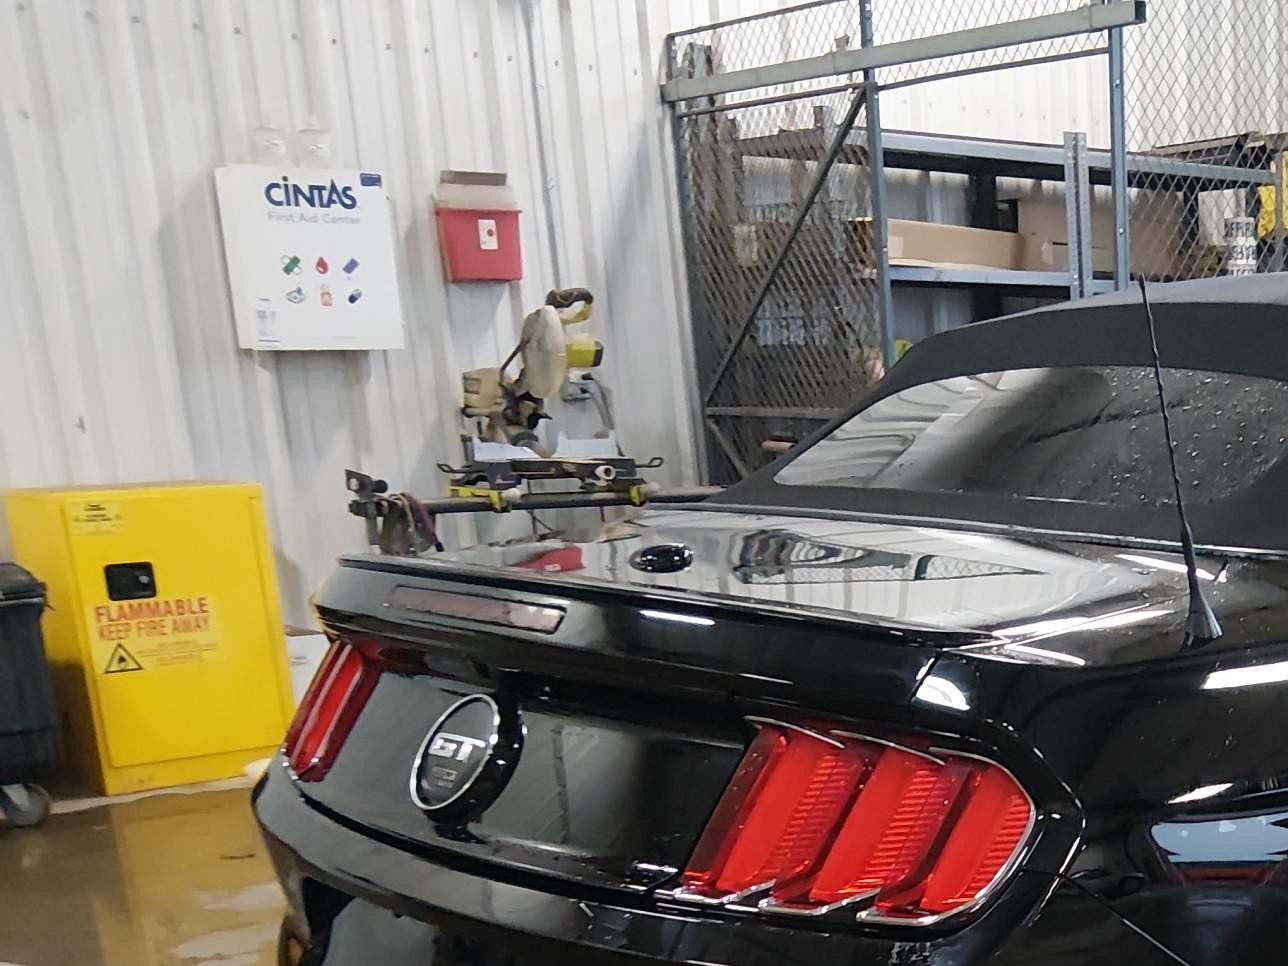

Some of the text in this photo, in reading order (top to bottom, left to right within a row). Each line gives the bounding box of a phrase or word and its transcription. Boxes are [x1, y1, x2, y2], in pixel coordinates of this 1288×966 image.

[95, 596, 209, 623] FLAMMABLE
[97, 615, 210, 641] KEEP FIRE AWAY
[427, 732, 487, 762] GT
